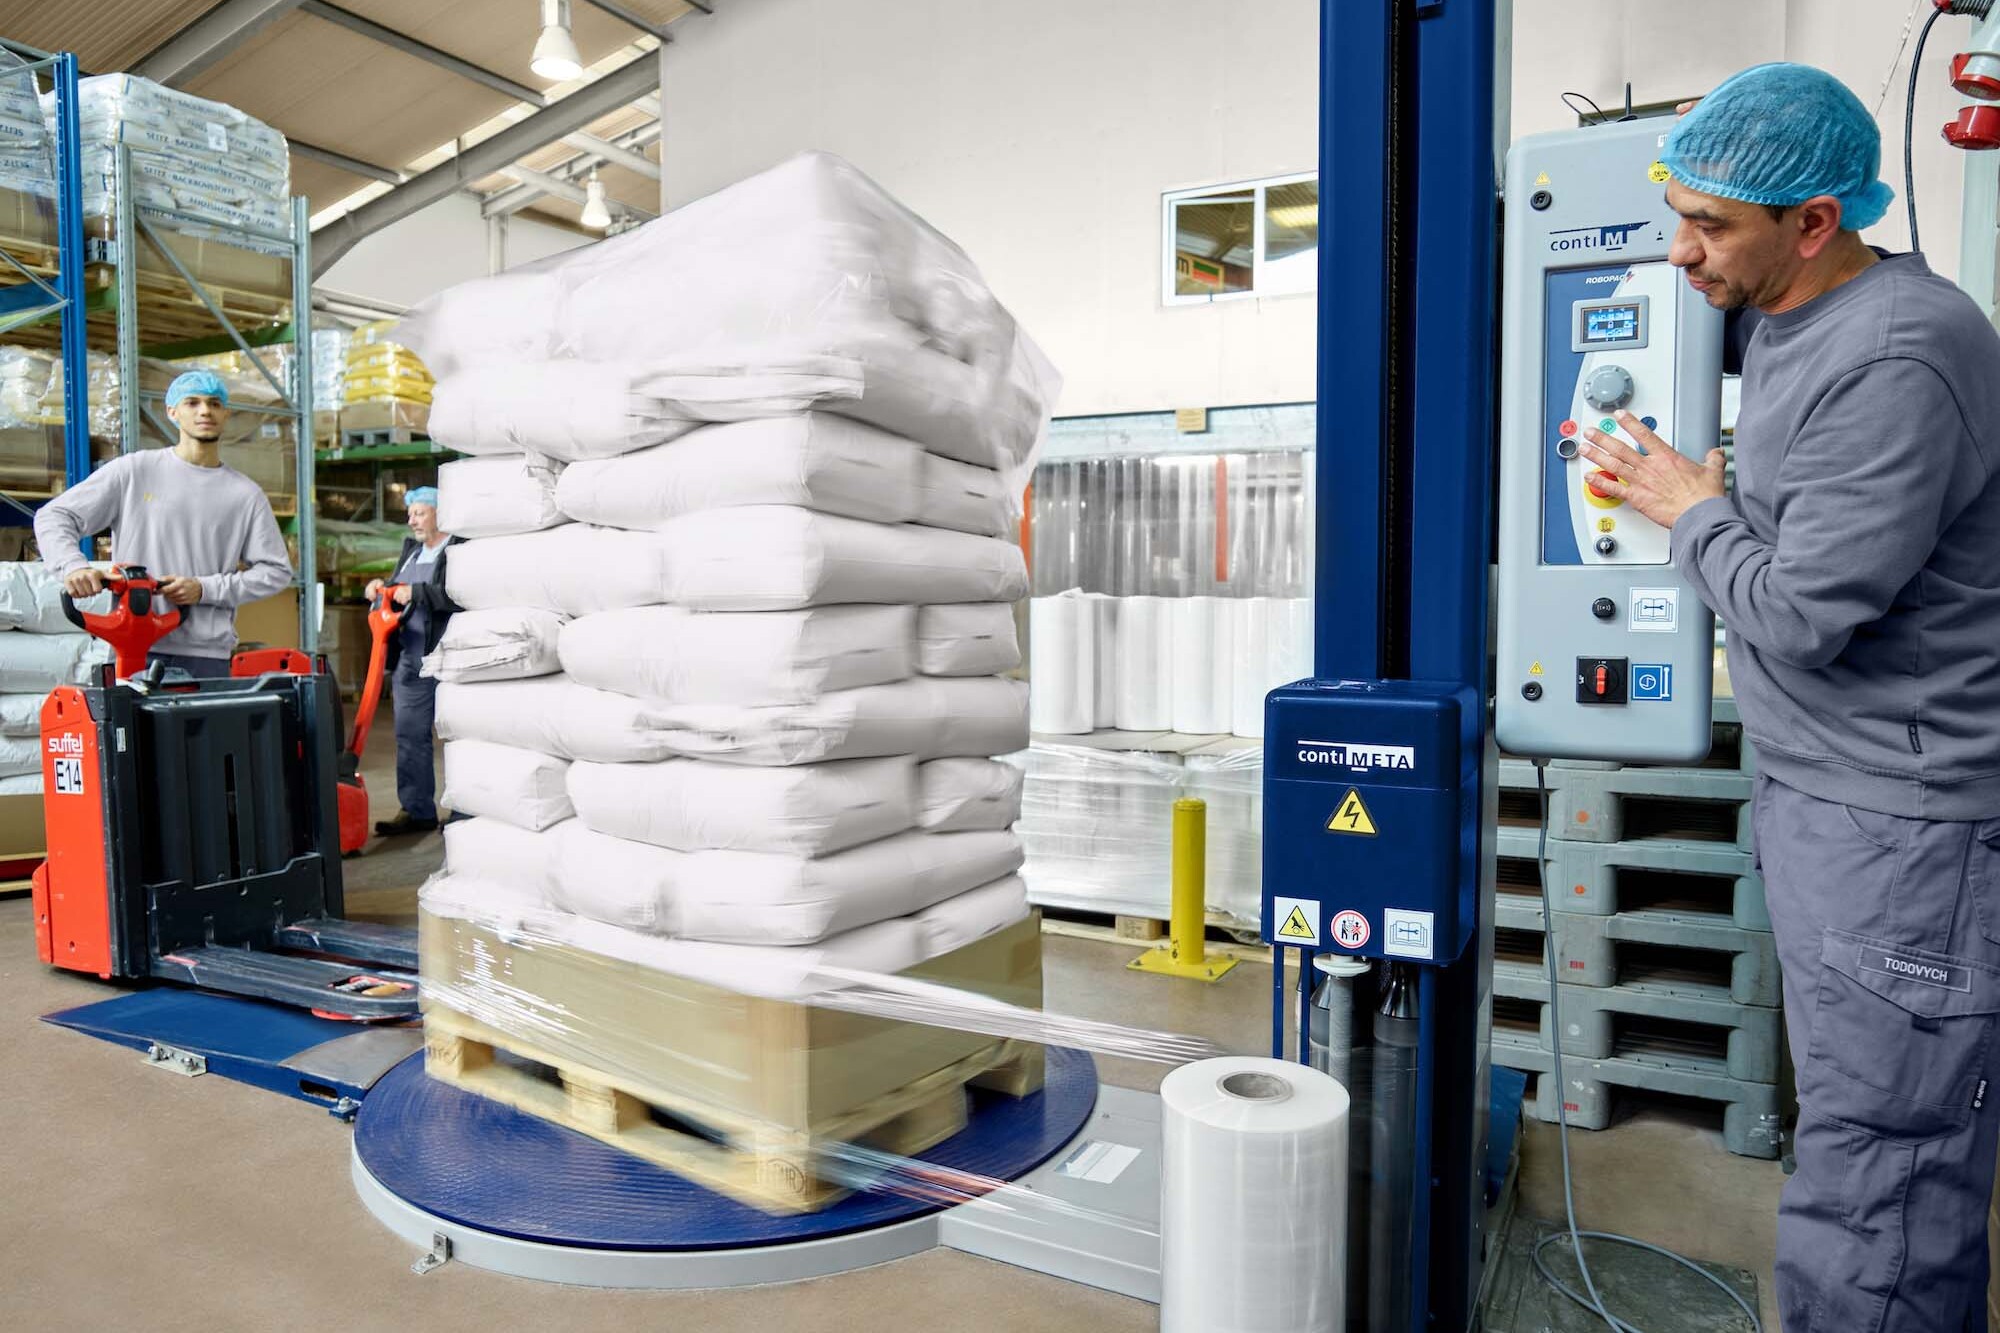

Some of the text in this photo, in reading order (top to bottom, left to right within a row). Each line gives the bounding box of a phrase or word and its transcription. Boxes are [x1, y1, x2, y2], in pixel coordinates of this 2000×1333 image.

[47, 732, 84, 753] suffel
[55, 760, 82, 791] E14
[1884, 957, 1948, 982] TODOVYCH
